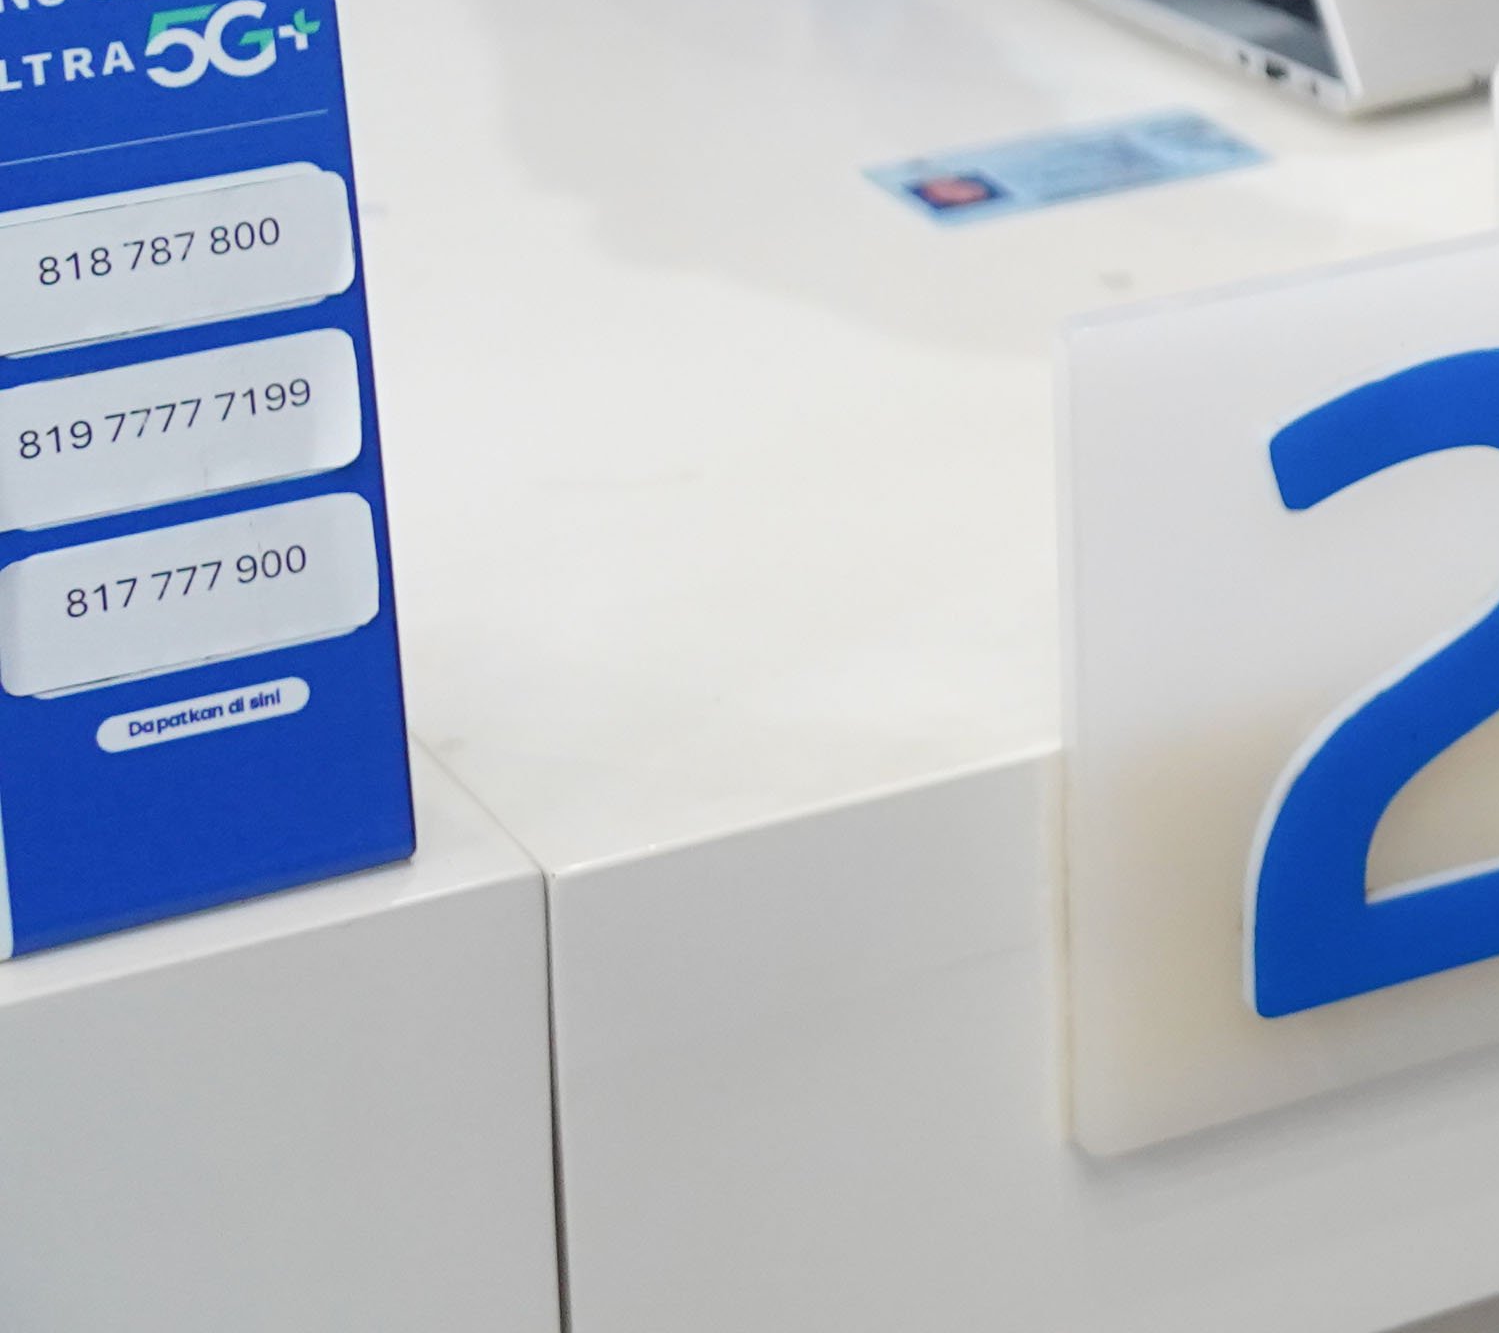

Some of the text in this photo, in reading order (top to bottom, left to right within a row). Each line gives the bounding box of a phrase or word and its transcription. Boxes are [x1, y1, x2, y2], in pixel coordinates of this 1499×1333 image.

[38, 217, 281, 286] 818 787 800
[18, 378, 311, 460] 819 7777 7199
[66, 544, 307, 618] 817 777 900
[128, 688, 282, 738] Dapatkan di sini
